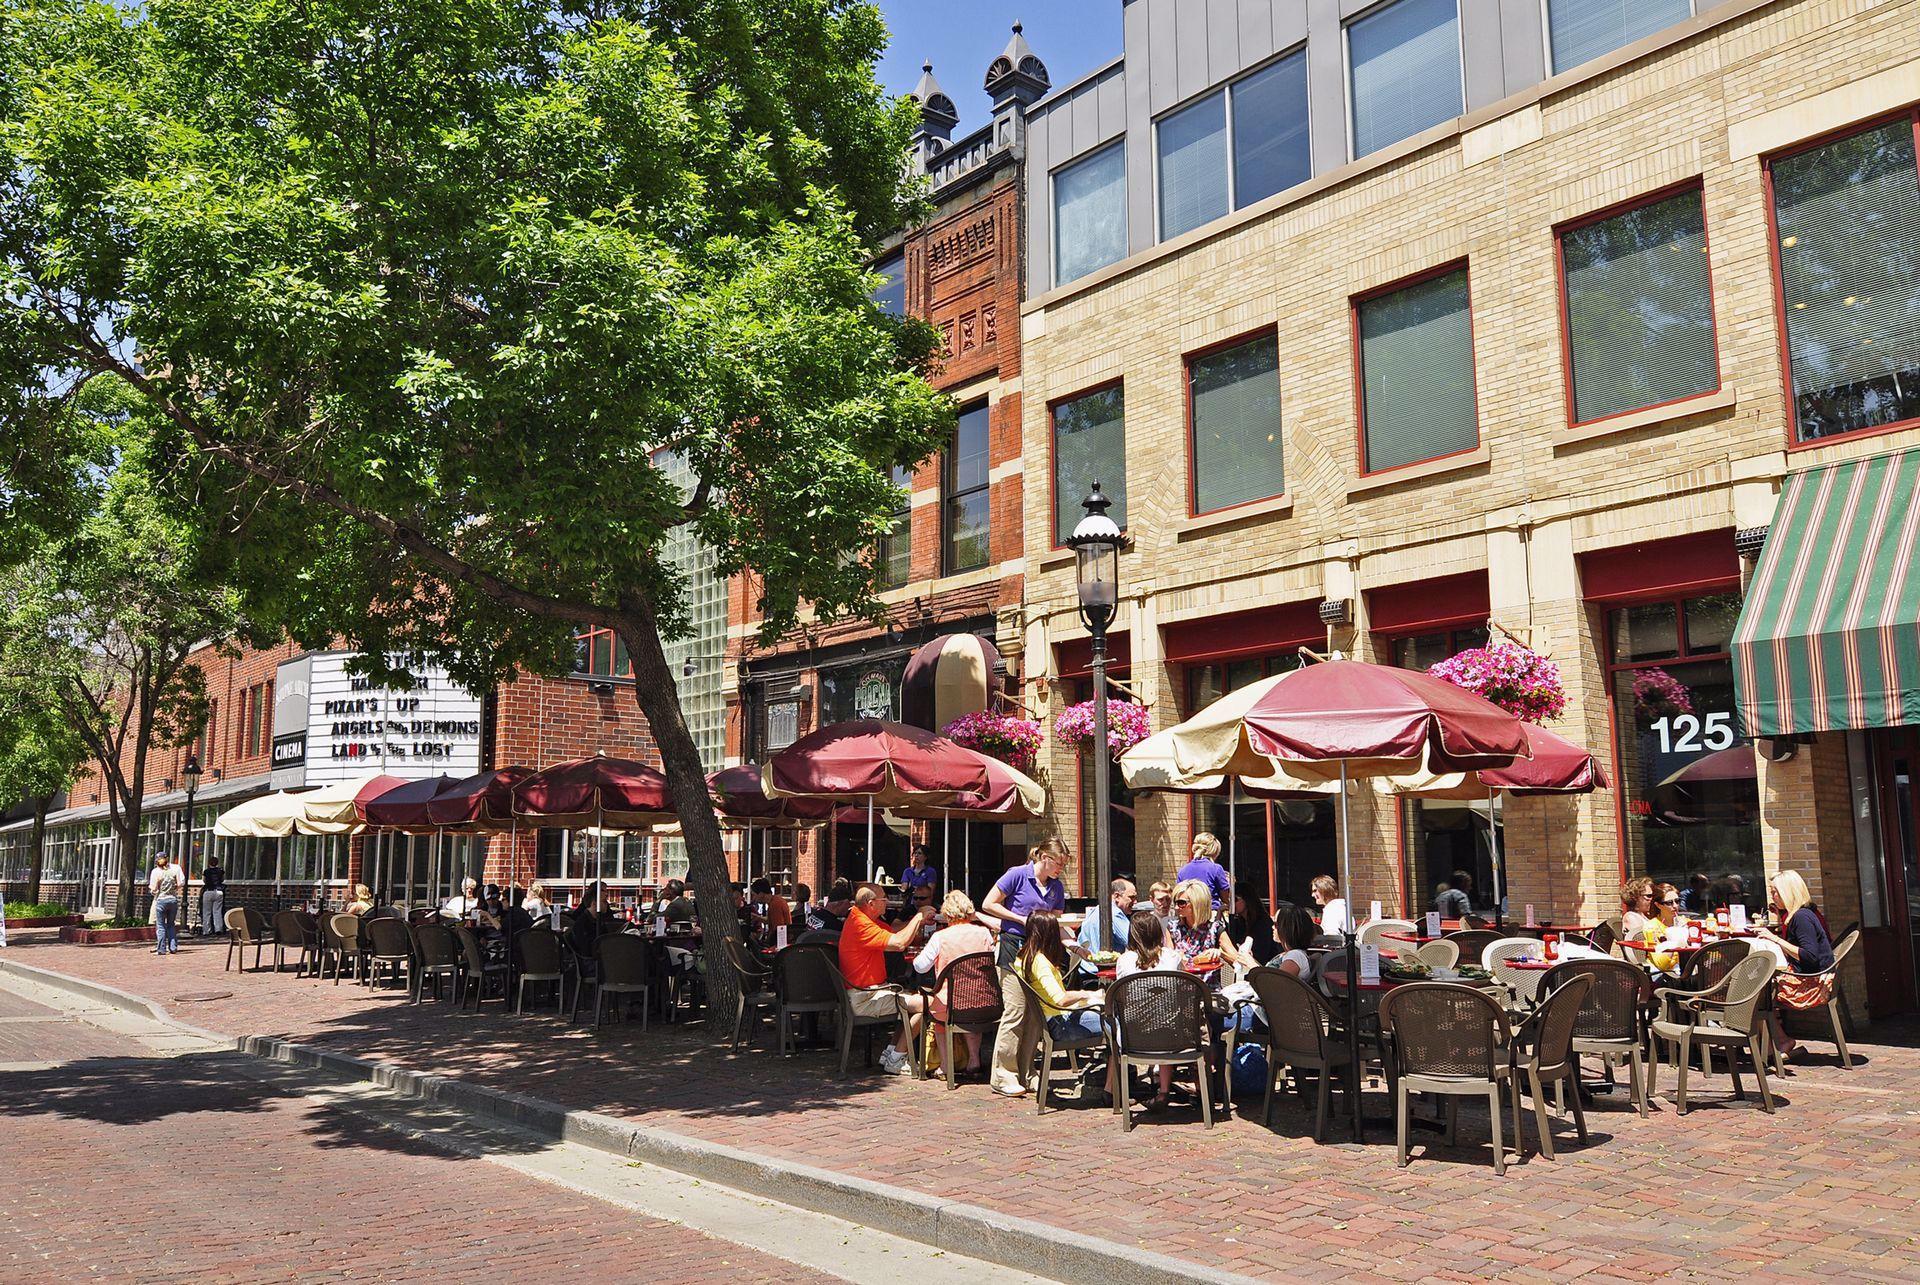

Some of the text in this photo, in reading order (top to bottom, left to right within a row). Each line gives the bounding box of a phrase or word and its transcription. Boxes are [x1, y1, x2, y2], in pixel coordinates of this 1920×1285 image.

[324, 697, 419, 714] PIXAR'S UP
[331, 721, 383, 735] ANGELS
[410, 720, 478, 734] DEMONS
[1650, 712, 1734, 753] 125
[274, 741, 302, 760] CINEMA
[331, 743, 367, 757] LAND
[412, 742, 453, 756] LOST
